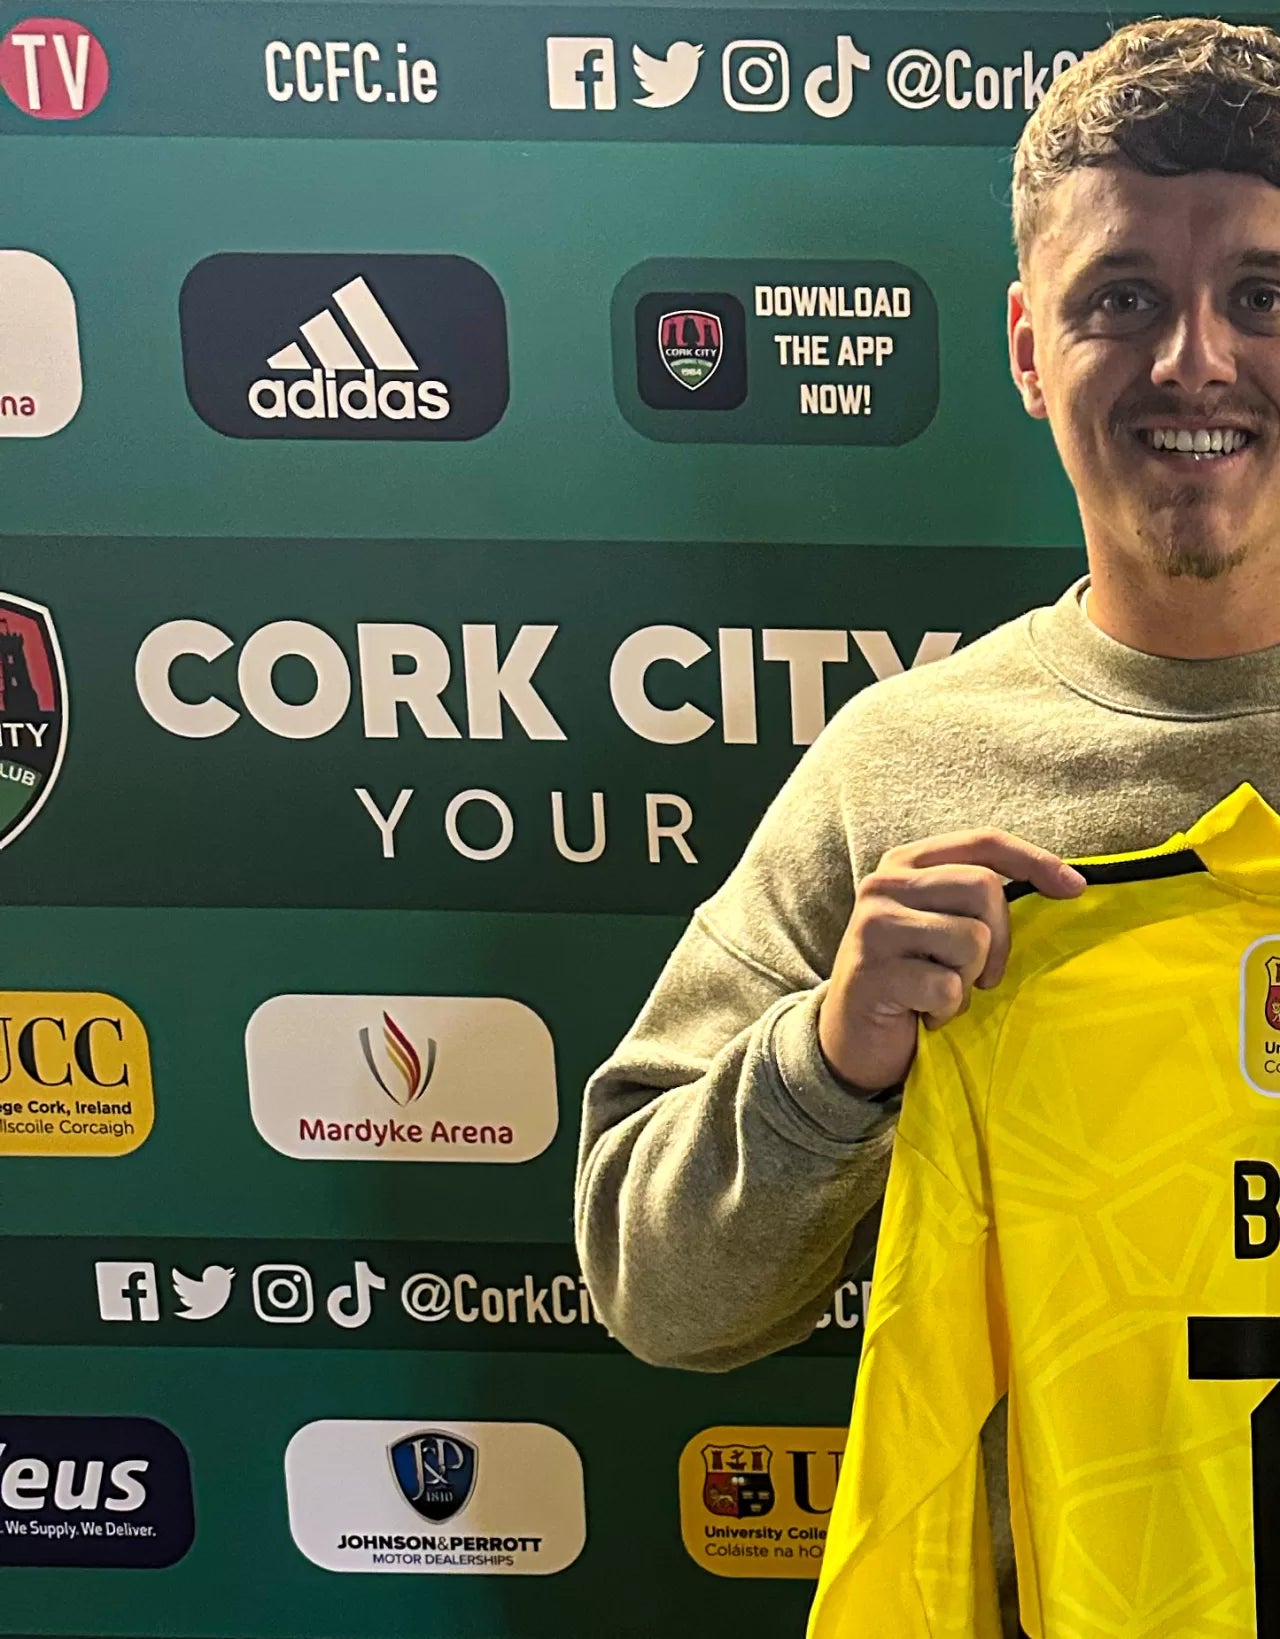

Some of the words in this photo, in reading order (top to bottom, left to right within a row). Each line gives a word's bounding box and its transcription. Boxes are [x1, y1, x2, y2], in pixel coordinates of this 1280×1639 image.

[12, 34, 90, 111] TV
[264, 40, 438, 104] CCFC.ie
[887, 48, 1092, 110] @Cork
[755, 286, 910, 317] DOWNLOAD
[774, 335, 830, 365] THE
[837, 336, 893, 366] APP
[248, 369, 450, 420] adidas
[800, 384, 871, 415] NOW!
[134, 619, 568, 741] CORK
[354, 787, 698, 865] YOUR
[28, 1100, 71, 1116] Cork,
[76, 1100, 132, 1114] Ireland
[59, 1119, 134, 1137] Corcaigh
[299, 1119, 422, 1147] Mardyke
[432, 1120, 513, 1145] Arena
[401, 1273, 604, 1324] @CorkCi
[0, 1443, 149, 1511] eus
[5, 1520, 27, 1535] We
[30, 1520, 79, 1539] Supply.
[81, 1522, 103, 1536] We
[106, 1522, 157, 1537] Deliver.
[337, 1535, 542, 1552] JOHNSON&PERROTT
[705, 1526, 782, 1541] University
[373, 1553, 421, 1565] MOTOR
[425, 1554, 514, 1566] DEALERSHIPS
[704, 1543, 768, 1558] Coláiste
[774, 1546, 793, 1557] na
